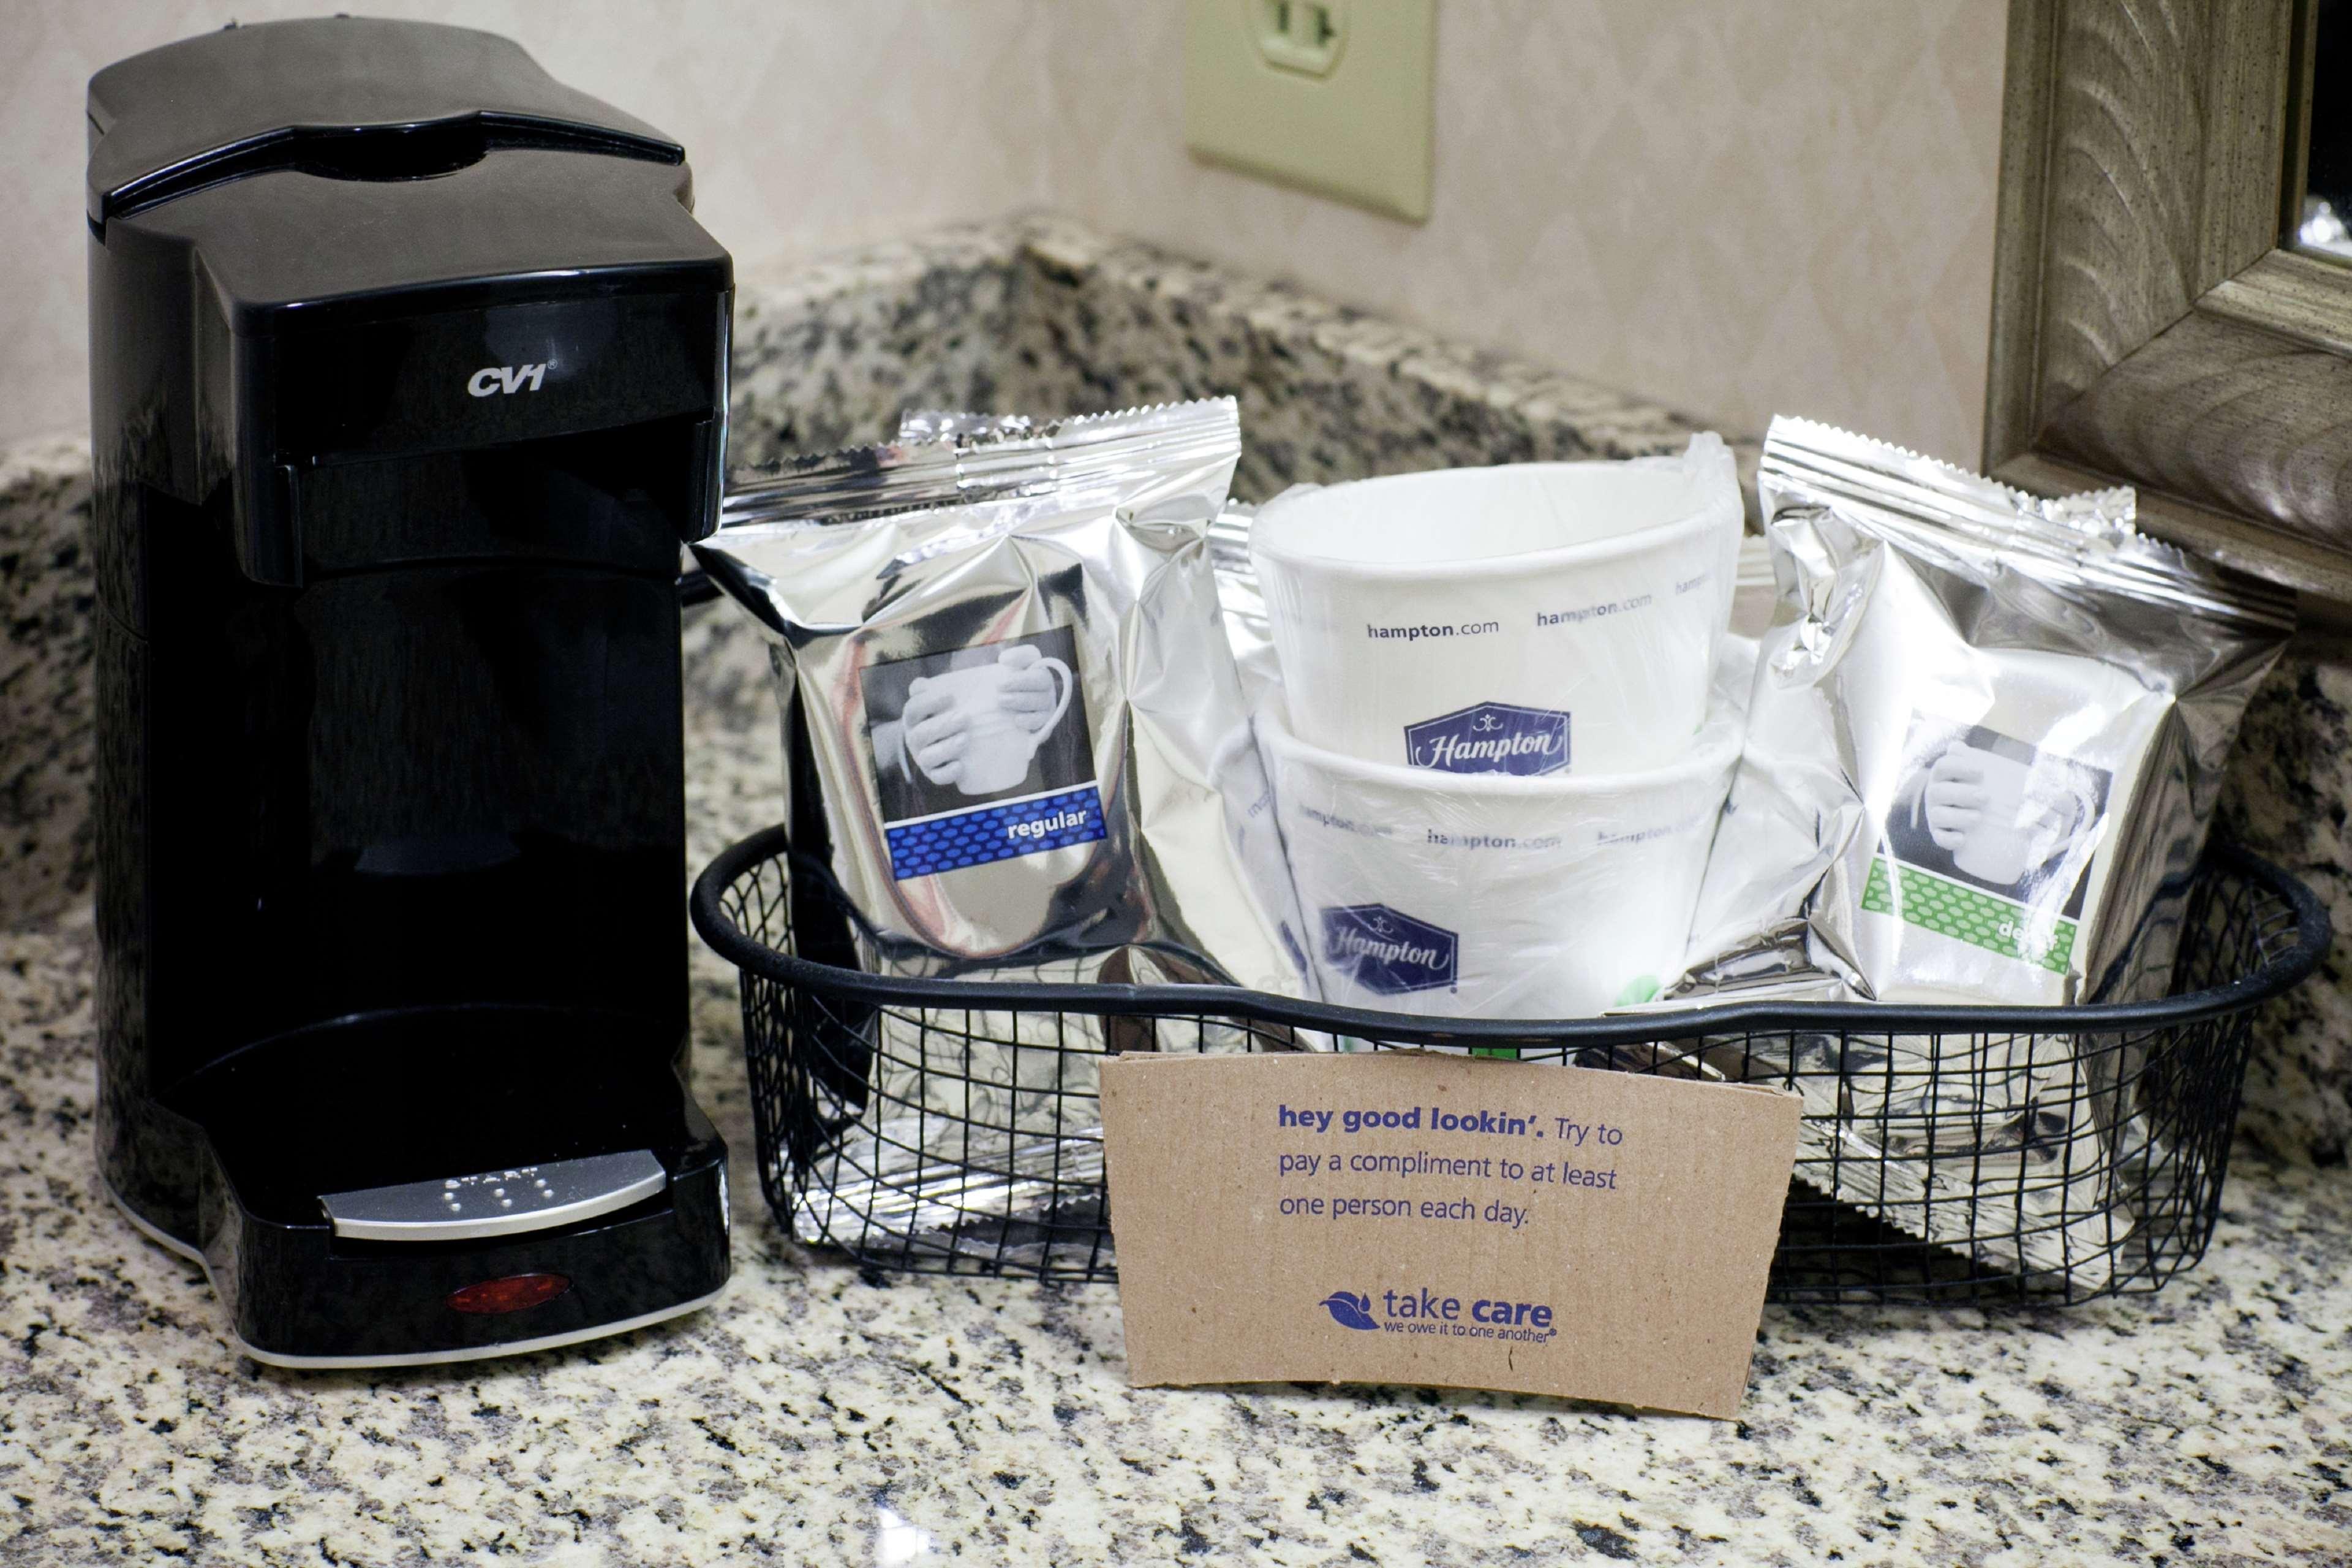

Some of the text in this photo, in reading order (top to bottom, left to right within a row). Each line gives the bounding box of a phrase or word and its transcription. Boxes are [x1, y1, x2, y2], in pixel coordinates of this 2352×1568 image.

[1366, 619, 1499, 641] hampton.com
[1415, 731, 1564, 769] Hampton
[1006, 809, 1088, 840] regular
[1328, 925, 1450, 970] Hampton
[1998, 919, 2059, 951] def
[1279, 1104, 1333, 1133] hey
[1343, 1107, 1421, 1133] good
[1555, 1117, 1590, 1147] Try
[1597, 1123, 1624, 1146] to
[1280, 1152, 1618, 1190] pay a compliment to at least
[1280, 1196, 1529, 1229] one person each day.
[1382, 1287, 1553, 1328] take care
[1384, 1322, 1404, 1333] we
[1408, 1322, 1437, 1335] owe
[1439, 1321, 1449, 1335] it
[1452, 1323, 1466, 1336] to
[1468, 1327, 1494, 1339] one
